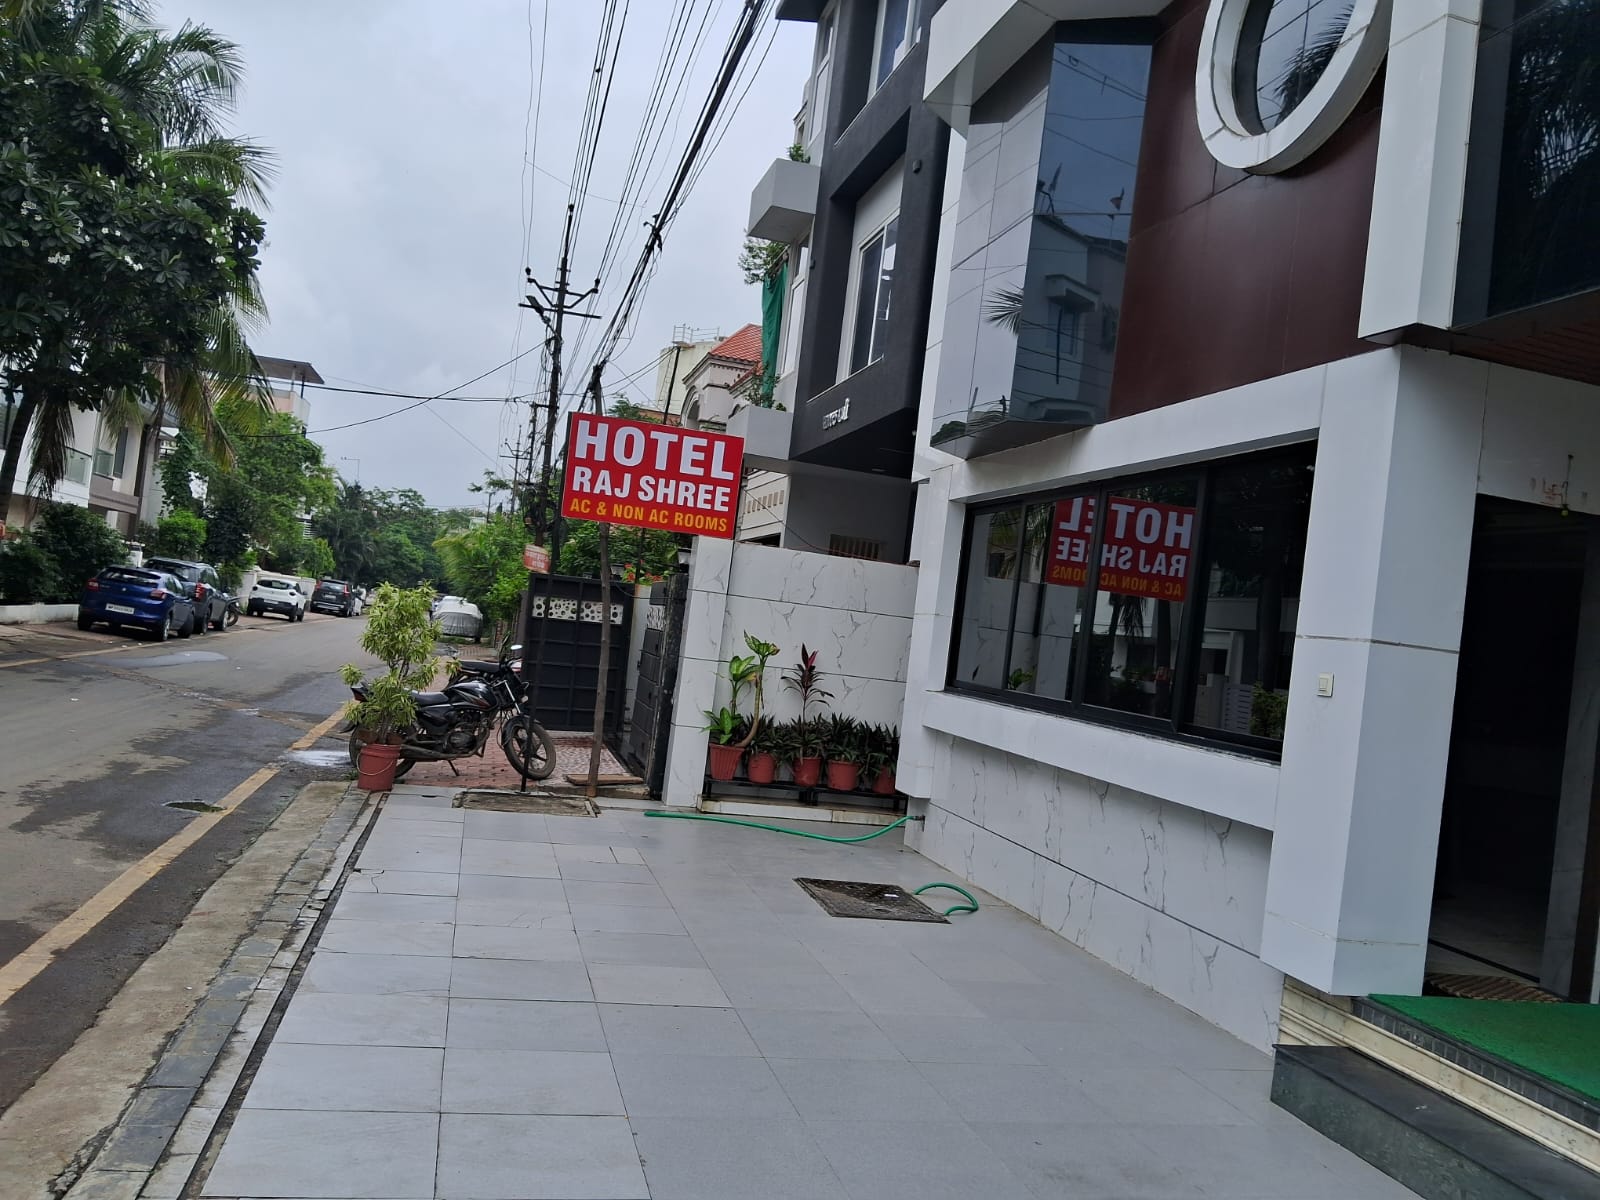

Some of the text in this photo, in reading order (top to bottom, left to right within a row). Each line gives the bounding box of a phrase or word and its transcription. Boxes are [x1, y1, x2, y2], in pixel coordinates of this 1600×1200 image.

[575, 420, 734, 481] HOTEL
[572, 466, 731, 512] RAJ SHREE
[570, 498, 728, 532] AC & NON AC ROOMS
